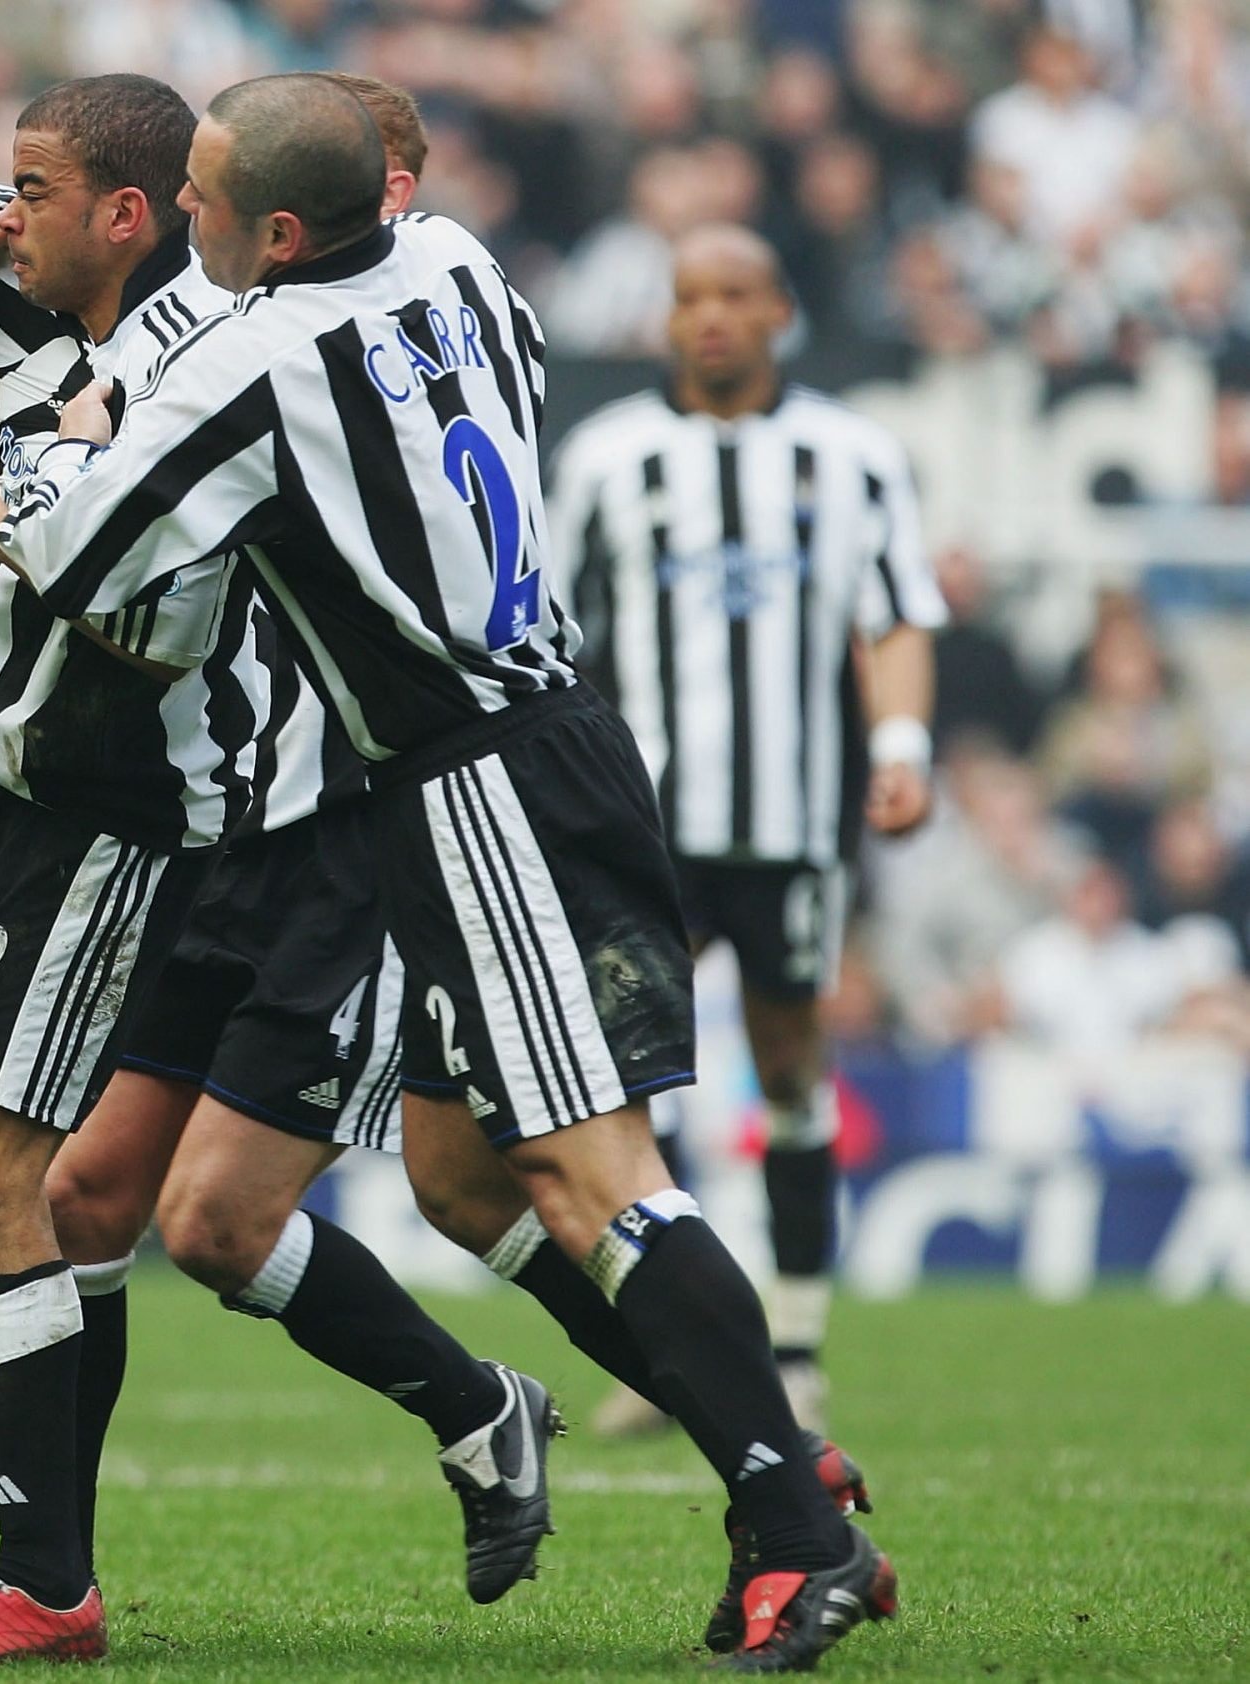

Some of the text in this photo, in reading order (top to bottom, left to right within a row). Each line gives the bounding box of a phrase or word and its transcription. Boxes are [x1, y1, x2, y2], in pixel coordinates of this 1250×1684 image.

[364, 305, 488, 404] CARR
[442, 416, 543, 652] 2
[328, 974, 370, 1060] 4
[424, 983, 472, 1077] 2
